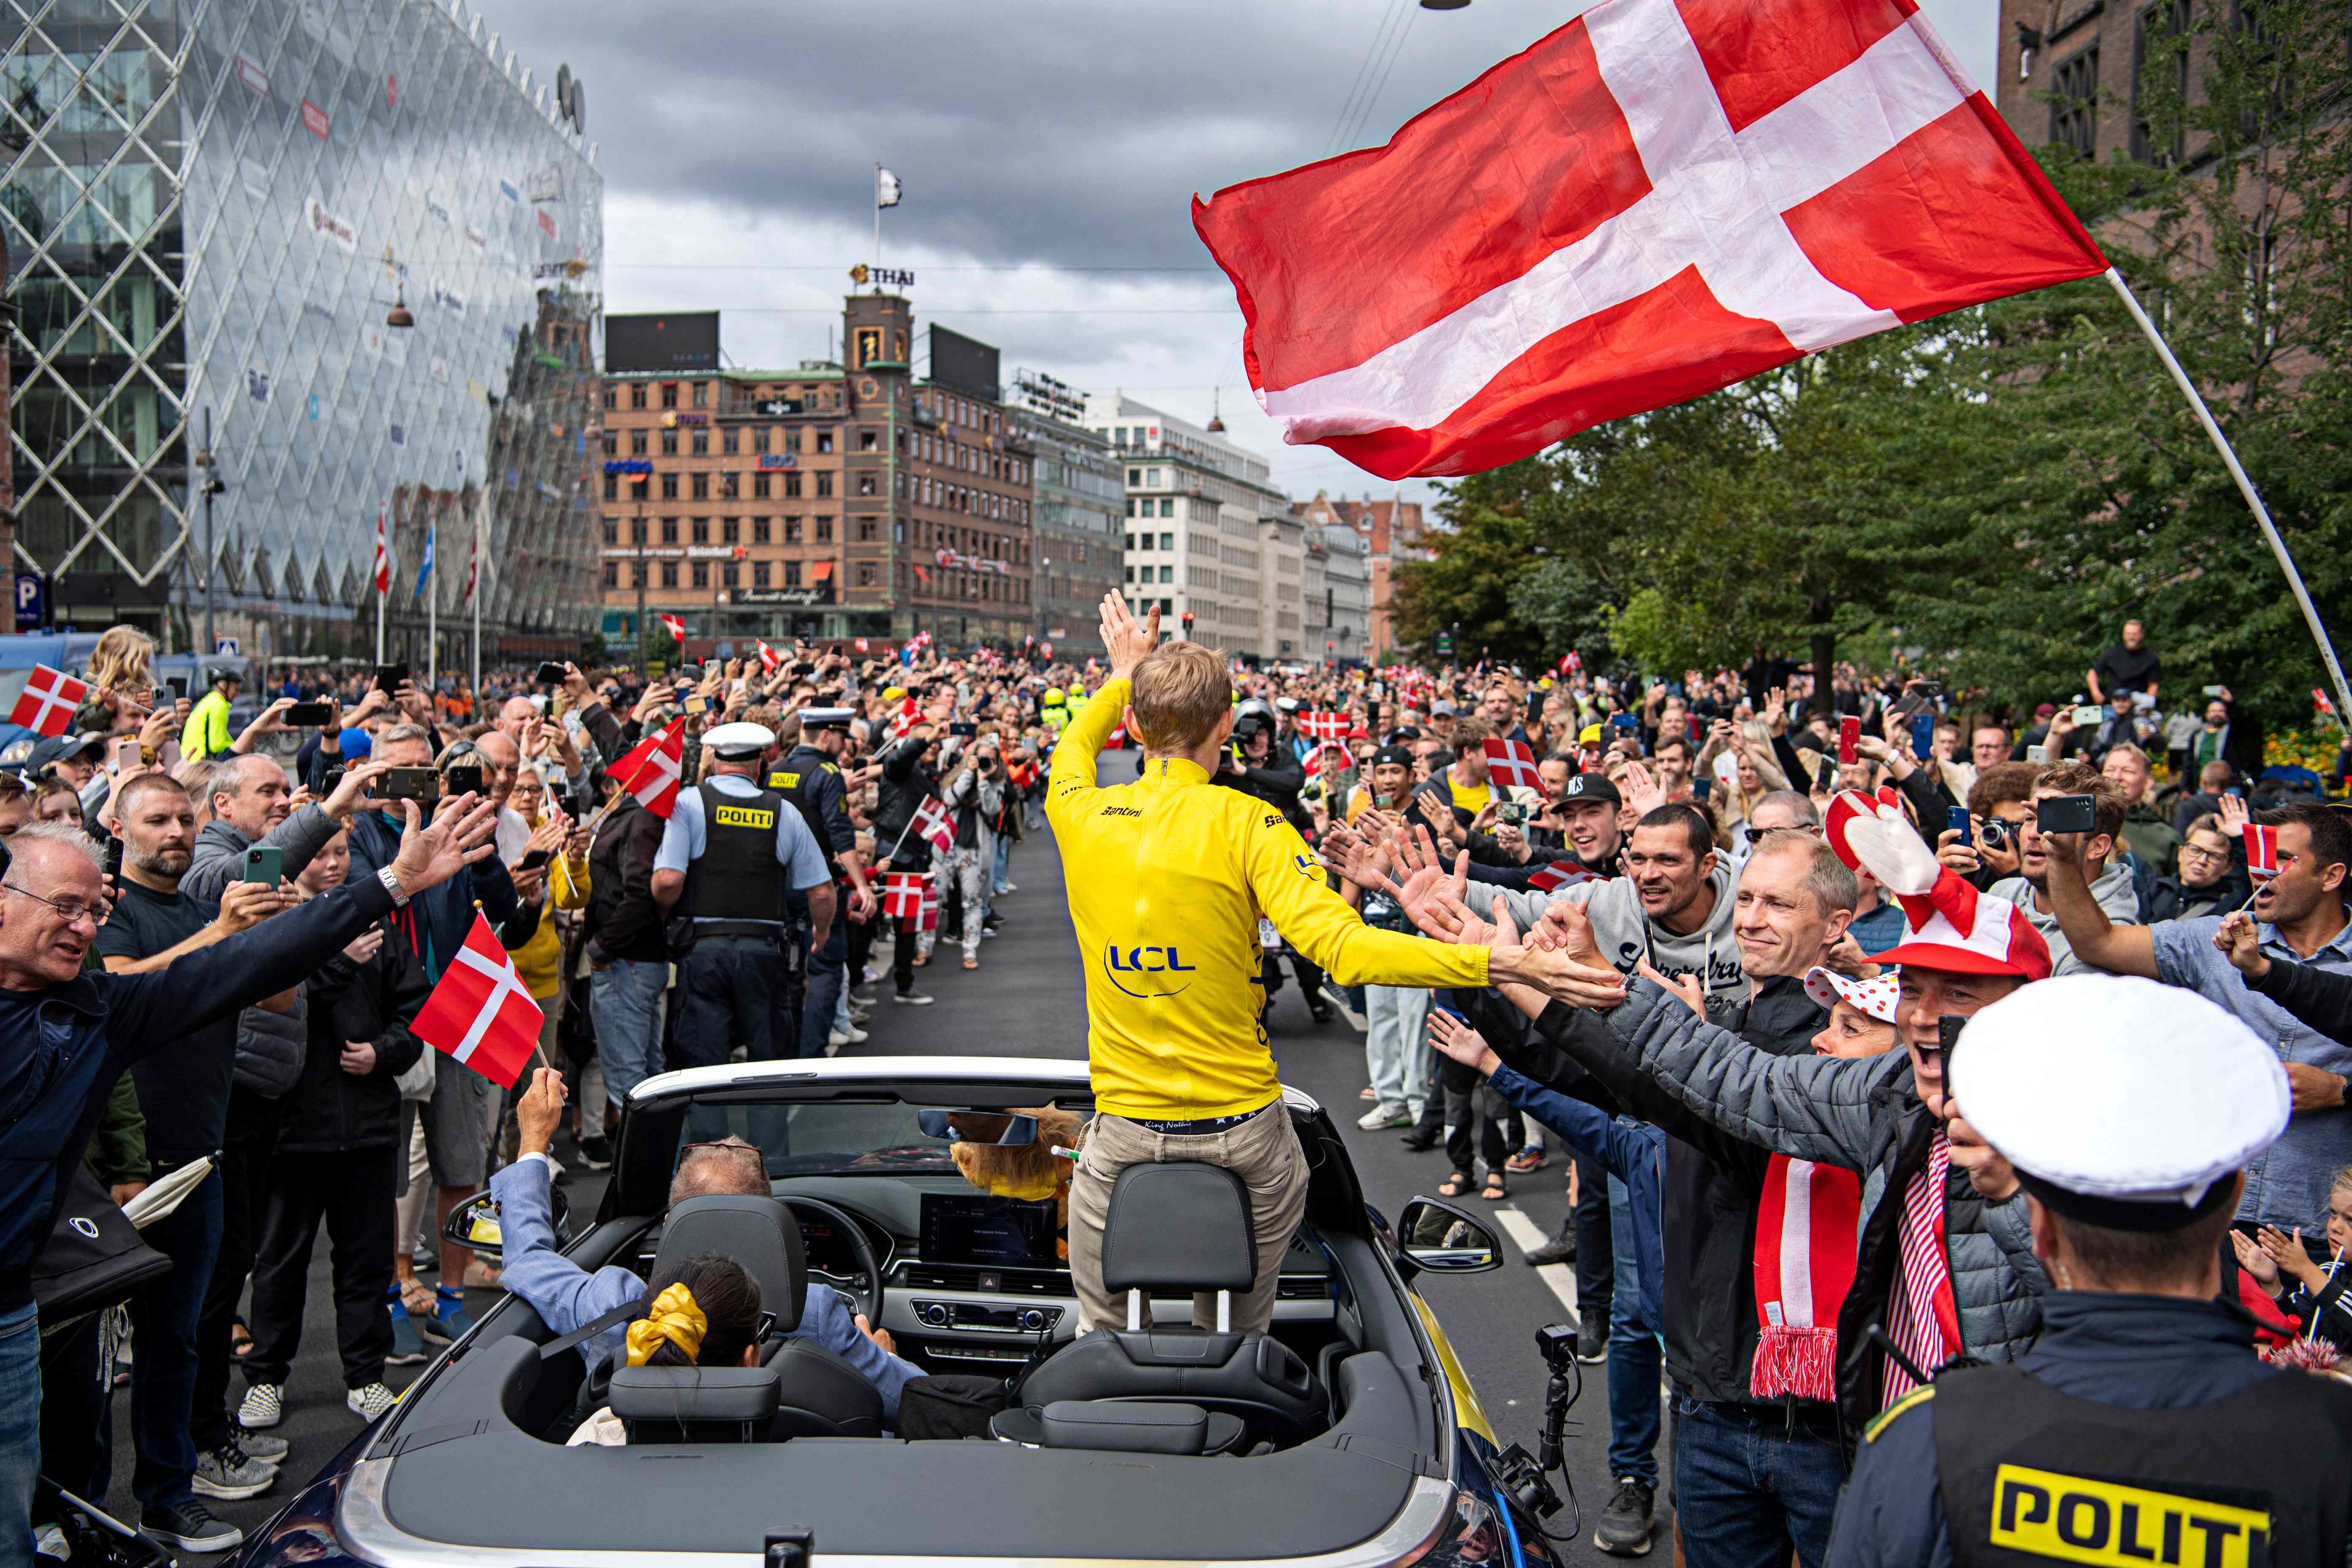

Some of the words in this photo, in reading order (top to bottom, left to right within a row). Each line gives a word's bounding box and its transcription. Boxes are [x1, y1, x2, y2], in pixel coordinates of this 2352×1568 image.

[871, 268, 915, 286] THAI
[761, 453, 797, 467] BDO
[19, 580, 37, 609] P
[772, 776, 799, 785] POLITI
[718, 810, 771, 825] POLITI
[1101, 806, 1144, 817] Santini
[1110, 946, 1196, 972] LCL
[1614, 942, 1742, 990] Sperdry
[1145, 1121, 1164, 1132] King
[2000, 1481, 2269, 1568] POLITI
